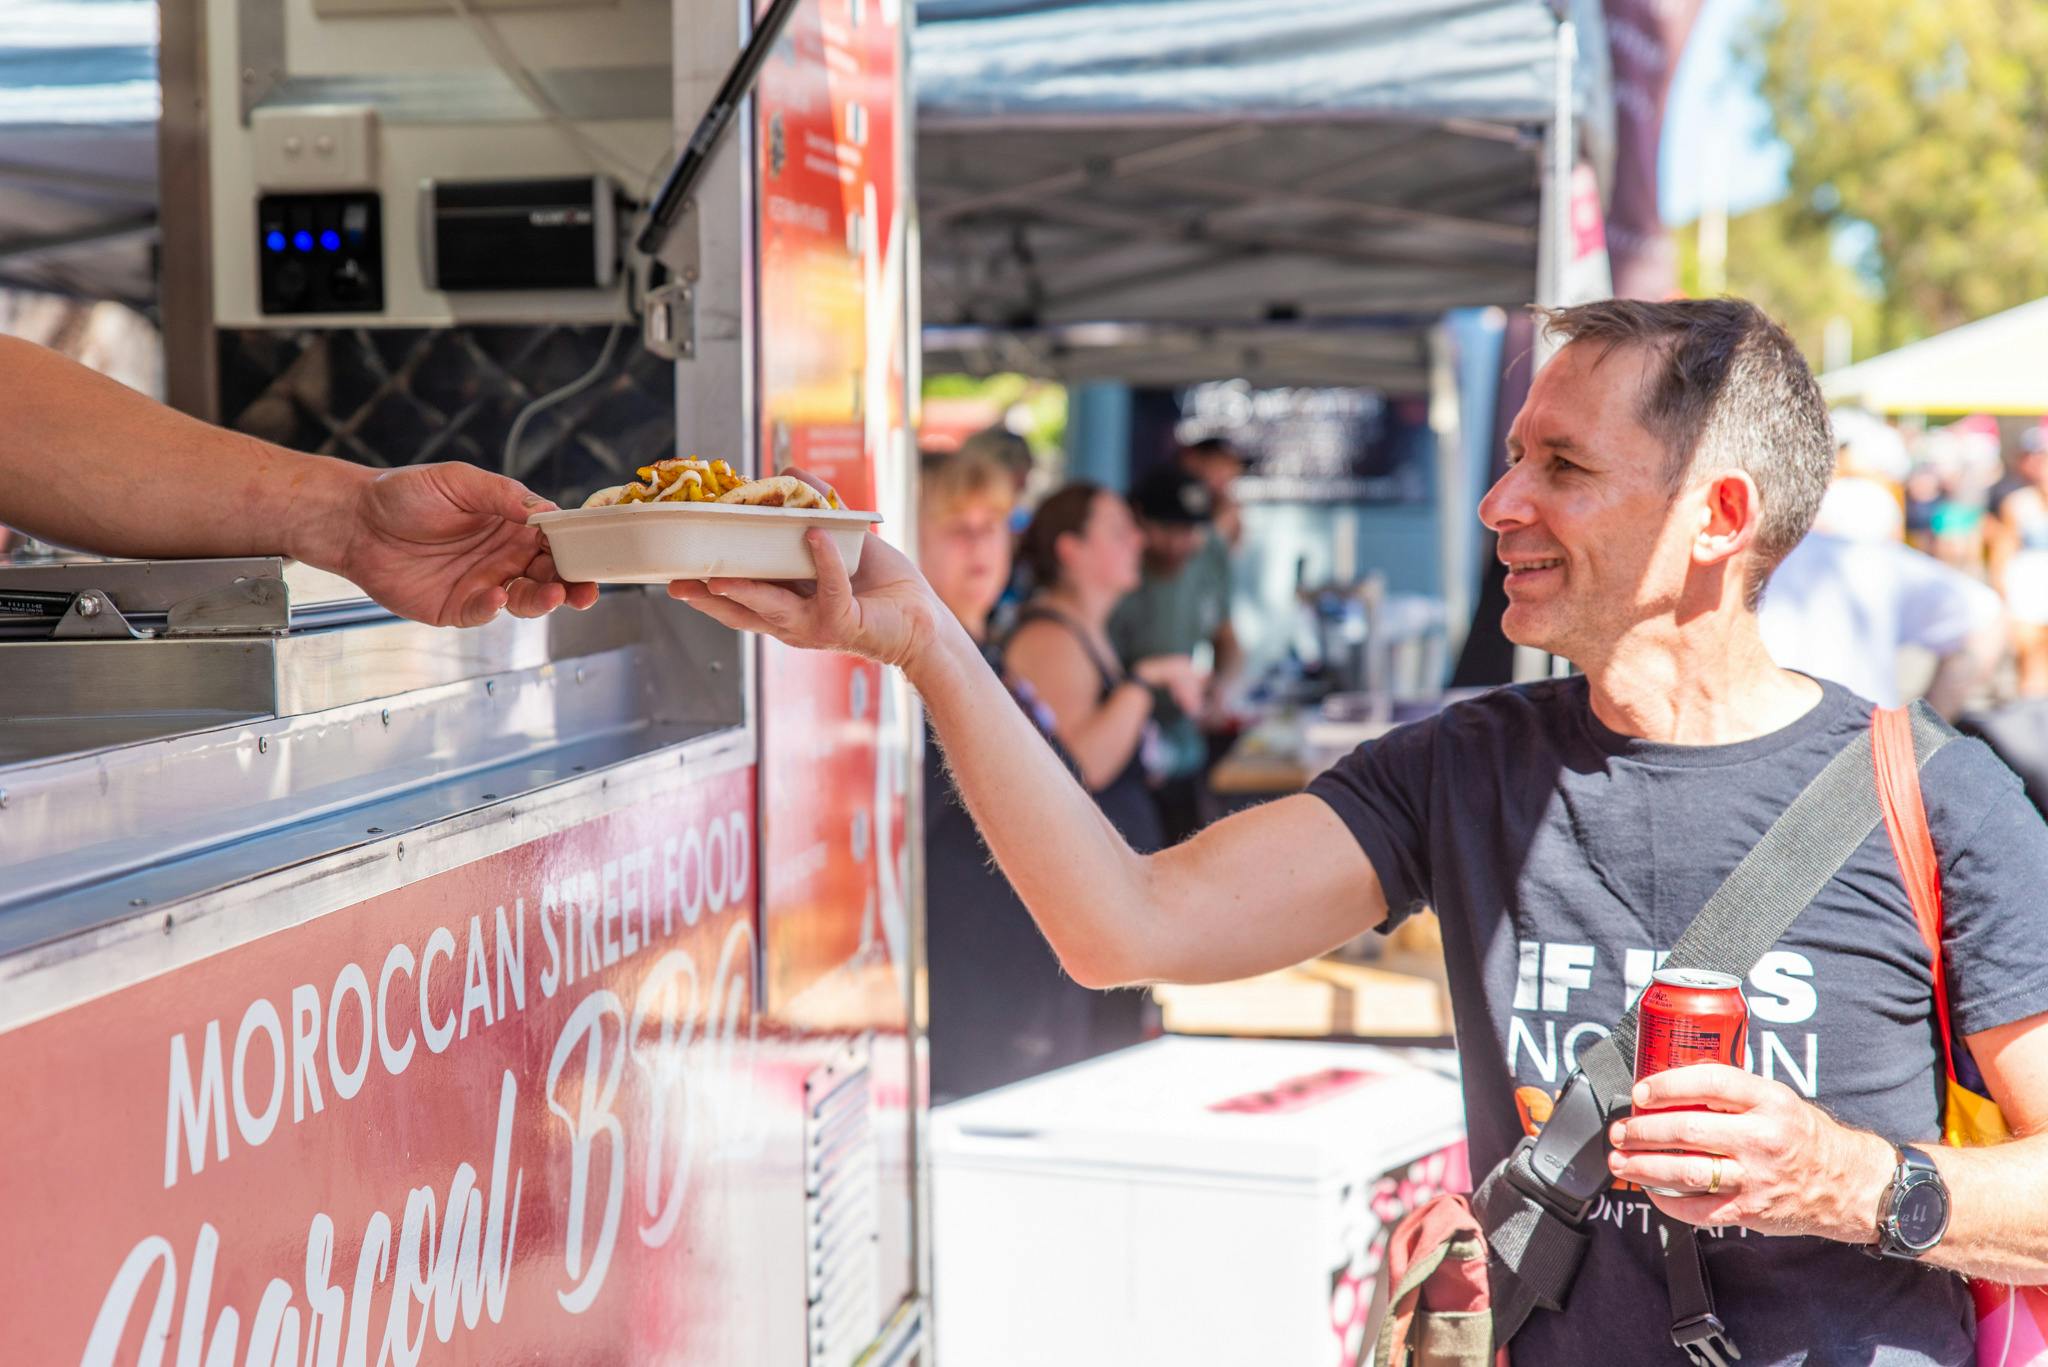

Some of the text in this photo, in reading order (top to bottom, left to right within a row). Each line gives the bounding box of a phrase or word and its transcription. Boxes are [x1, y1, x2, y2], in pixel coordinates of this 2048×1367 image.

[163, 811, 749, 1190] MOROCCAN STREET FOOD
[1512, 941, 1595, 1012] IF
[80, 1068, 523, 1367] Charcoal
